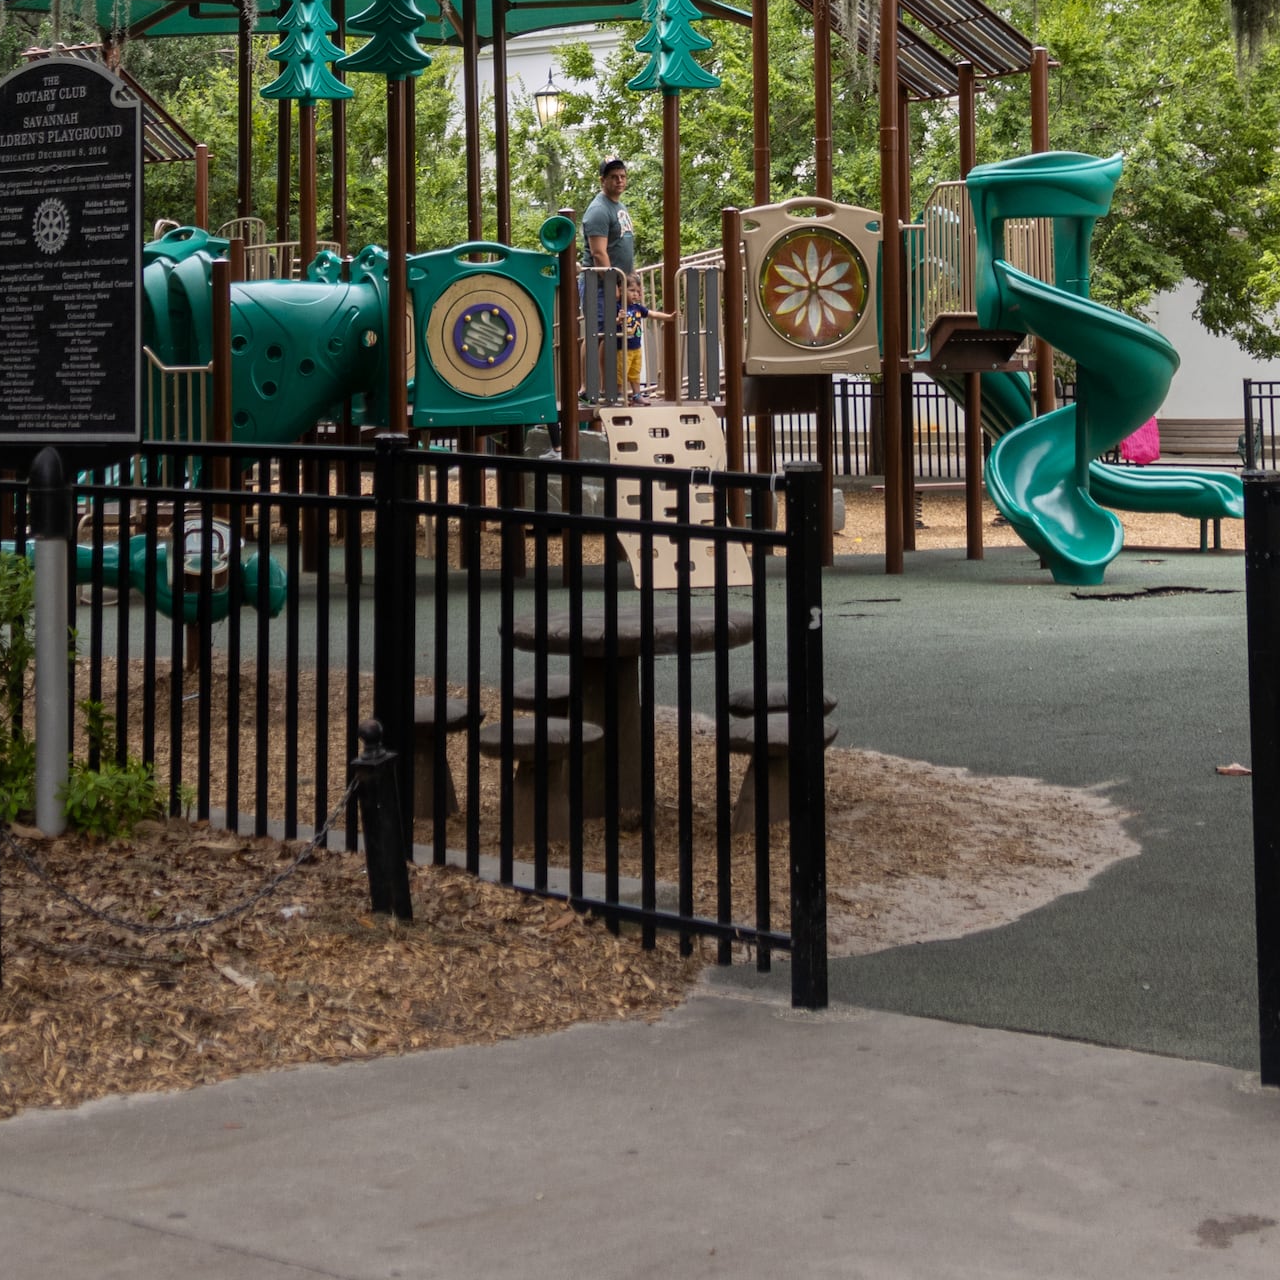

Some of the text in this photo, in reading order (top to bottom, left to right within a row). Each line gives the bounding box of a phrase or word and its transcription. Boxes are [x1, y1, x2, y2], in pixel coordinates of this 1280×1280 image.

[43, 76, 59, 85] THE
[16, 86, 86, 104] ROTARY CLUB
[47, 104, 55, 112] OF
[23, 112, 78, 128] SAVANNAH
[48, 125, 122, 144] PLAYGROUND
[38, 150, 76, 160] DECEMBER
[88, 146, 106, 155] 2014
